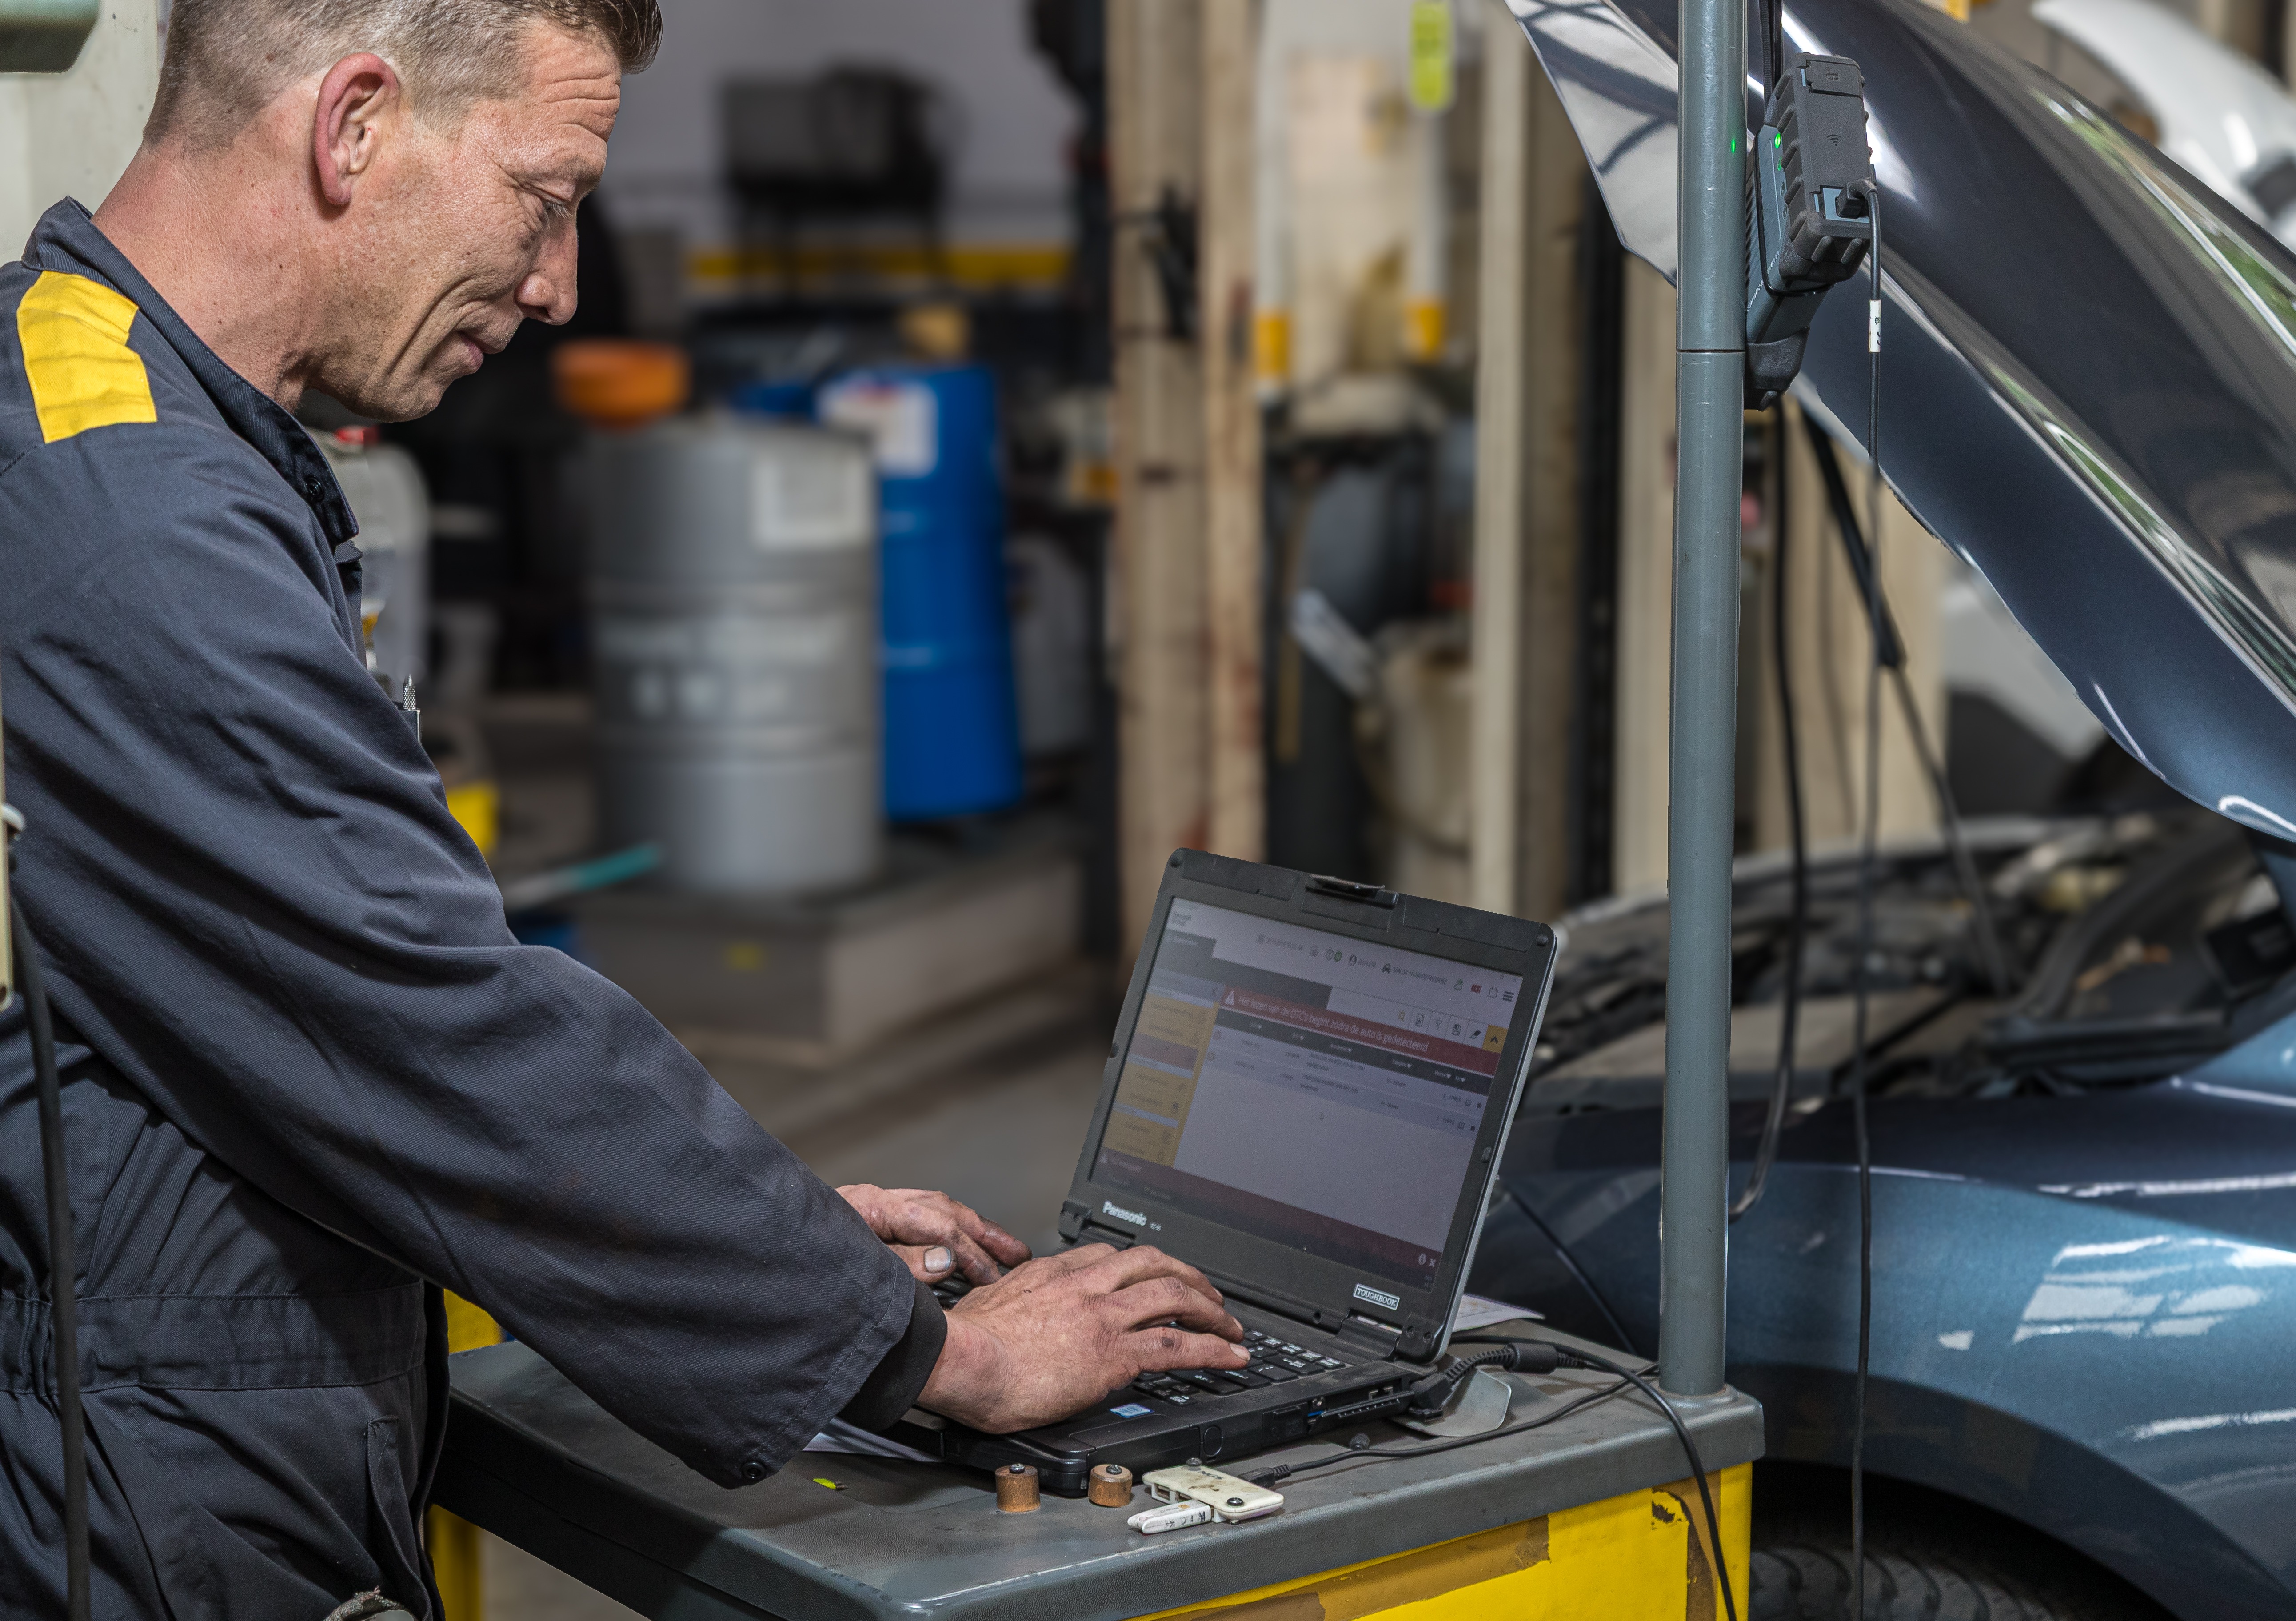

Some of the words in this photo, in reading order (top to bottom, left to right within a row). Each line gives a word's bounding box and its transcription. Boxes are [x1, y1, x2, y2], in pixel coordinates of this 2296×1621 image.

[1330, 1021, 1349, 1032] zodra
[1350, 1024, 1359, 1034] de
[1360, 1029, 1375, 1038] auto
[1376, 1031, 1382, 1040] is
[1383, 1034, 1429, 1052] gedetecteerd
[1102, 1200, 1147, 1226] Panasonic
[1357, 1288, 1397, 1307] TOUGHBOOK
